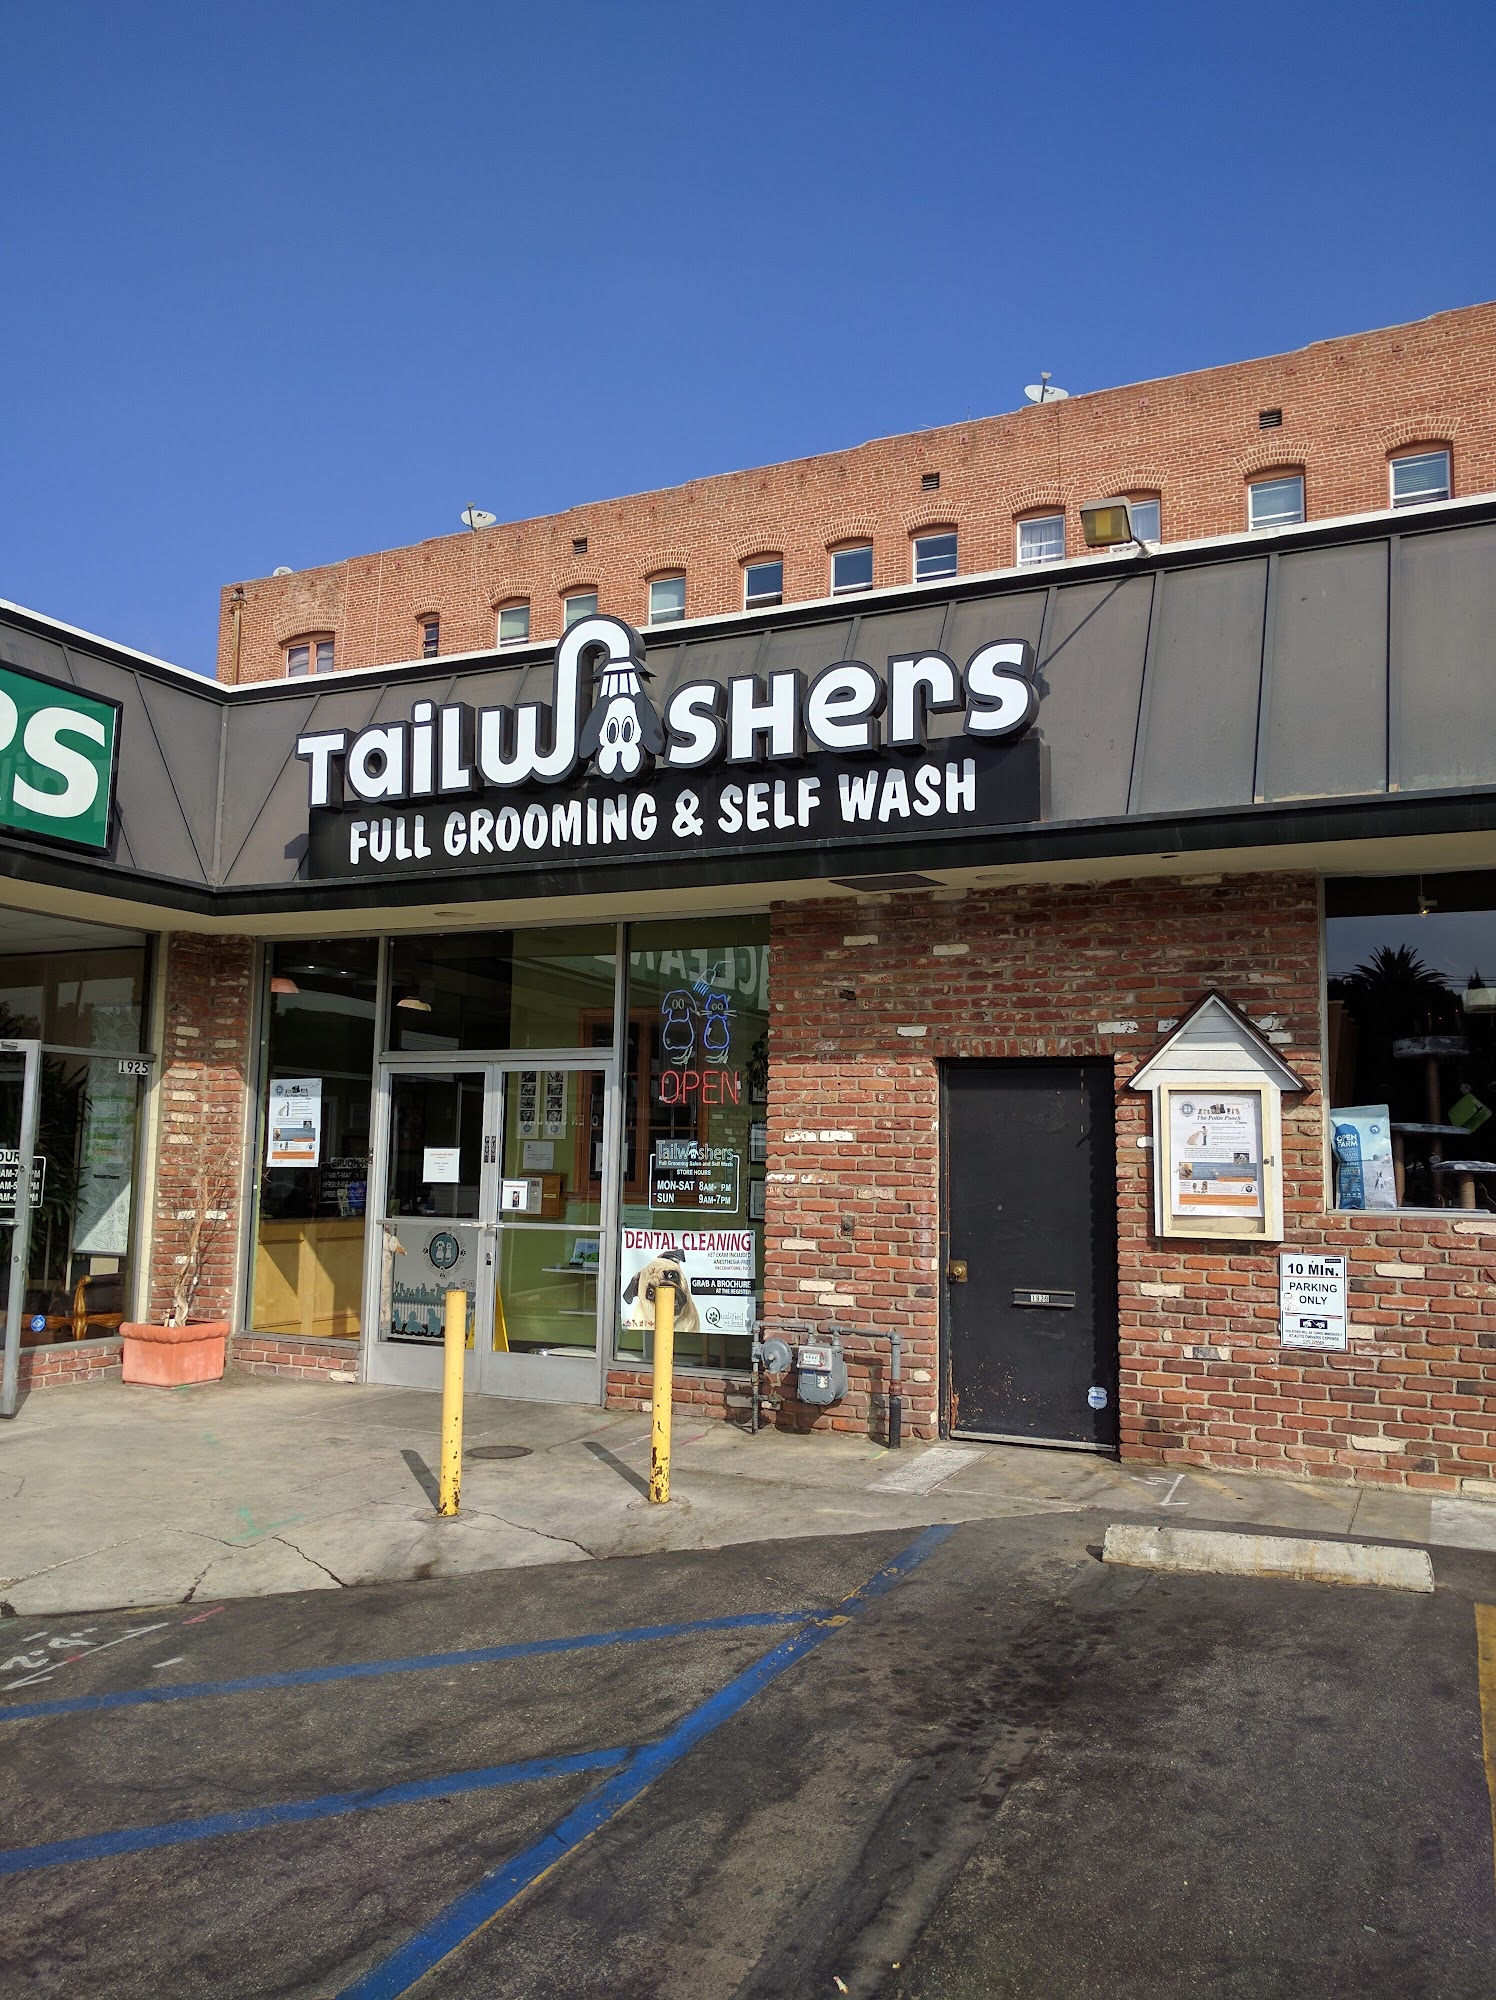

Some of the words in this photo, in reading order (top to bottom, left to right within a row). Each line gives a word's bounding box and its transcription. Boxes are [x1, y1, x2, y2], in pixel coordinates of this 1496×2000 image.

[0, 689, 105, 818] S
[350, 814, 432, 865] FULL
[443, 793, 658, 857] GROOMING
[671, 788, 704, 838] &
[717, 776, 821, 834] SELF
[837, 757, 977, 823] WASH
[120, 1060, 149, 1074] 1925
[660, 1069, 740, 1105] OPEN
[1336, 1134, 1357, 1142] OPEN
[1337, 1140, 1358, 1148] FARM
[667, 1160, 688, 1168] Grooming
[656, 1180, 696, 1191] MON-SAT
[656, 1192, 675, 1204] SUN
[698, 1194, 732, 1205] 9AM-7PM
[625, 1230, 679, 1251] DENTAL
[682, 1232, 751, 1252] CLEANING
[1287, 1263, 1304, 1275] 10
[1308, 1264, 1339, 1277] MIN.
[691, 1279, 710, 1288] GRAB
[710, 1279, 716, 1288] A
[716, 1279, 752, 1289] BROCHURE
[1289, 1281, 1338, 1293] PARKING
[1299, 1295, 1328, 1305] ONLY
